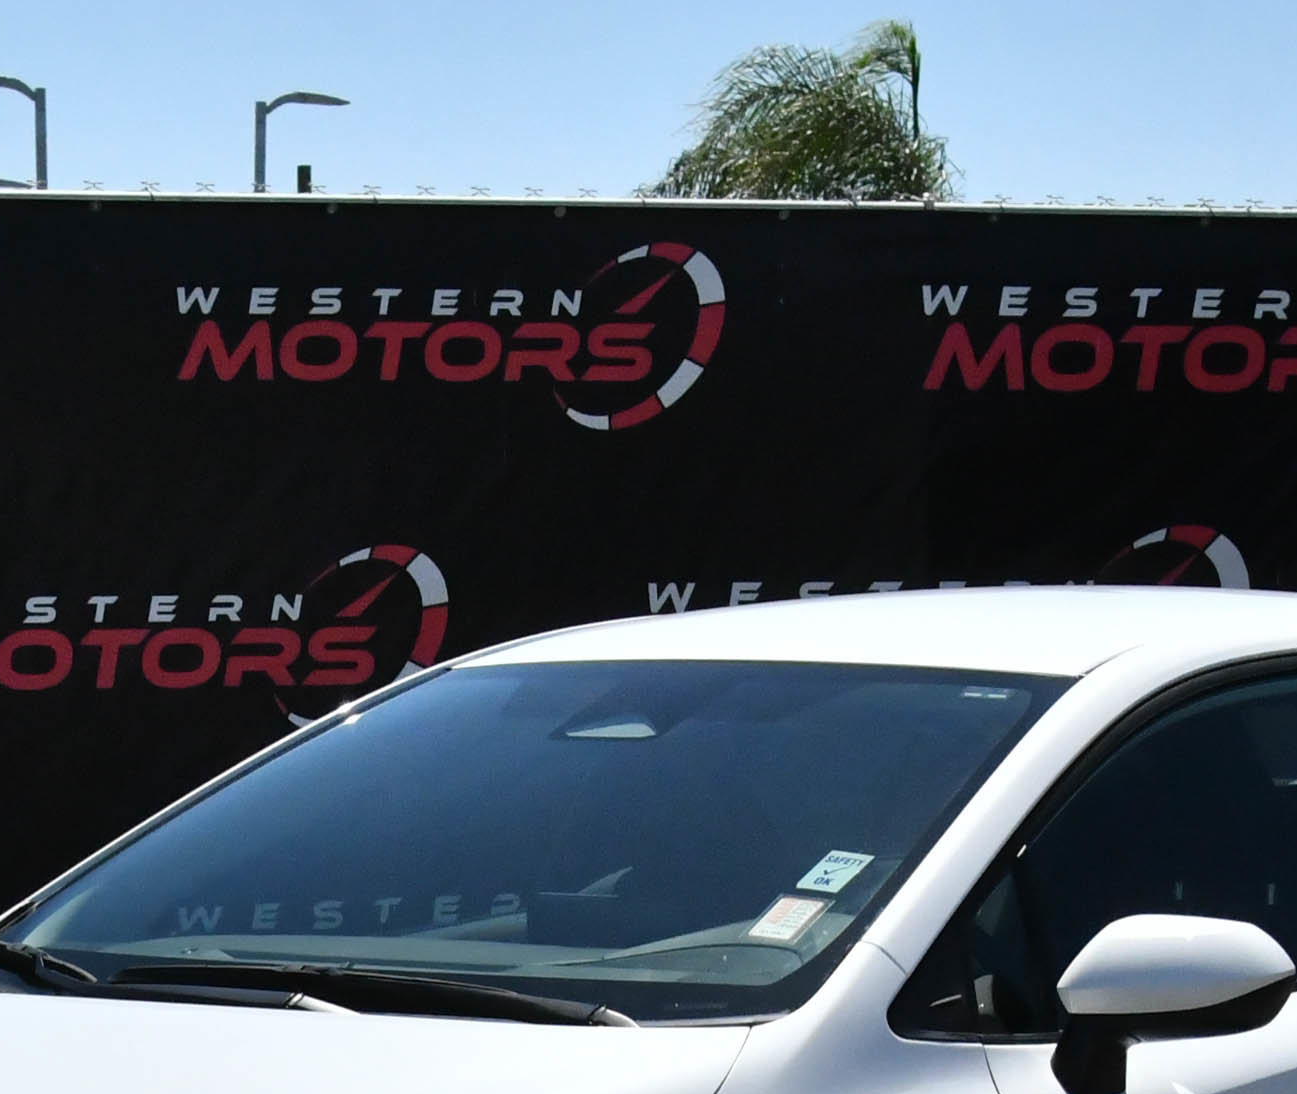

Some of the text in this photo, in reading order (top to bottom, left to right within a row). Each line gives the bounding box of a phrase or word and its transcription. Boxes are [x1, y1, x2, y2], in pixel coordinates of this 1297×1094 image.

[178, 288, 582, 317] WESTERN
[180, 321, 656, 383] MOTORS
[825, 855, 864, 867] SAFETY
[813, 876, 835, 887] OK
